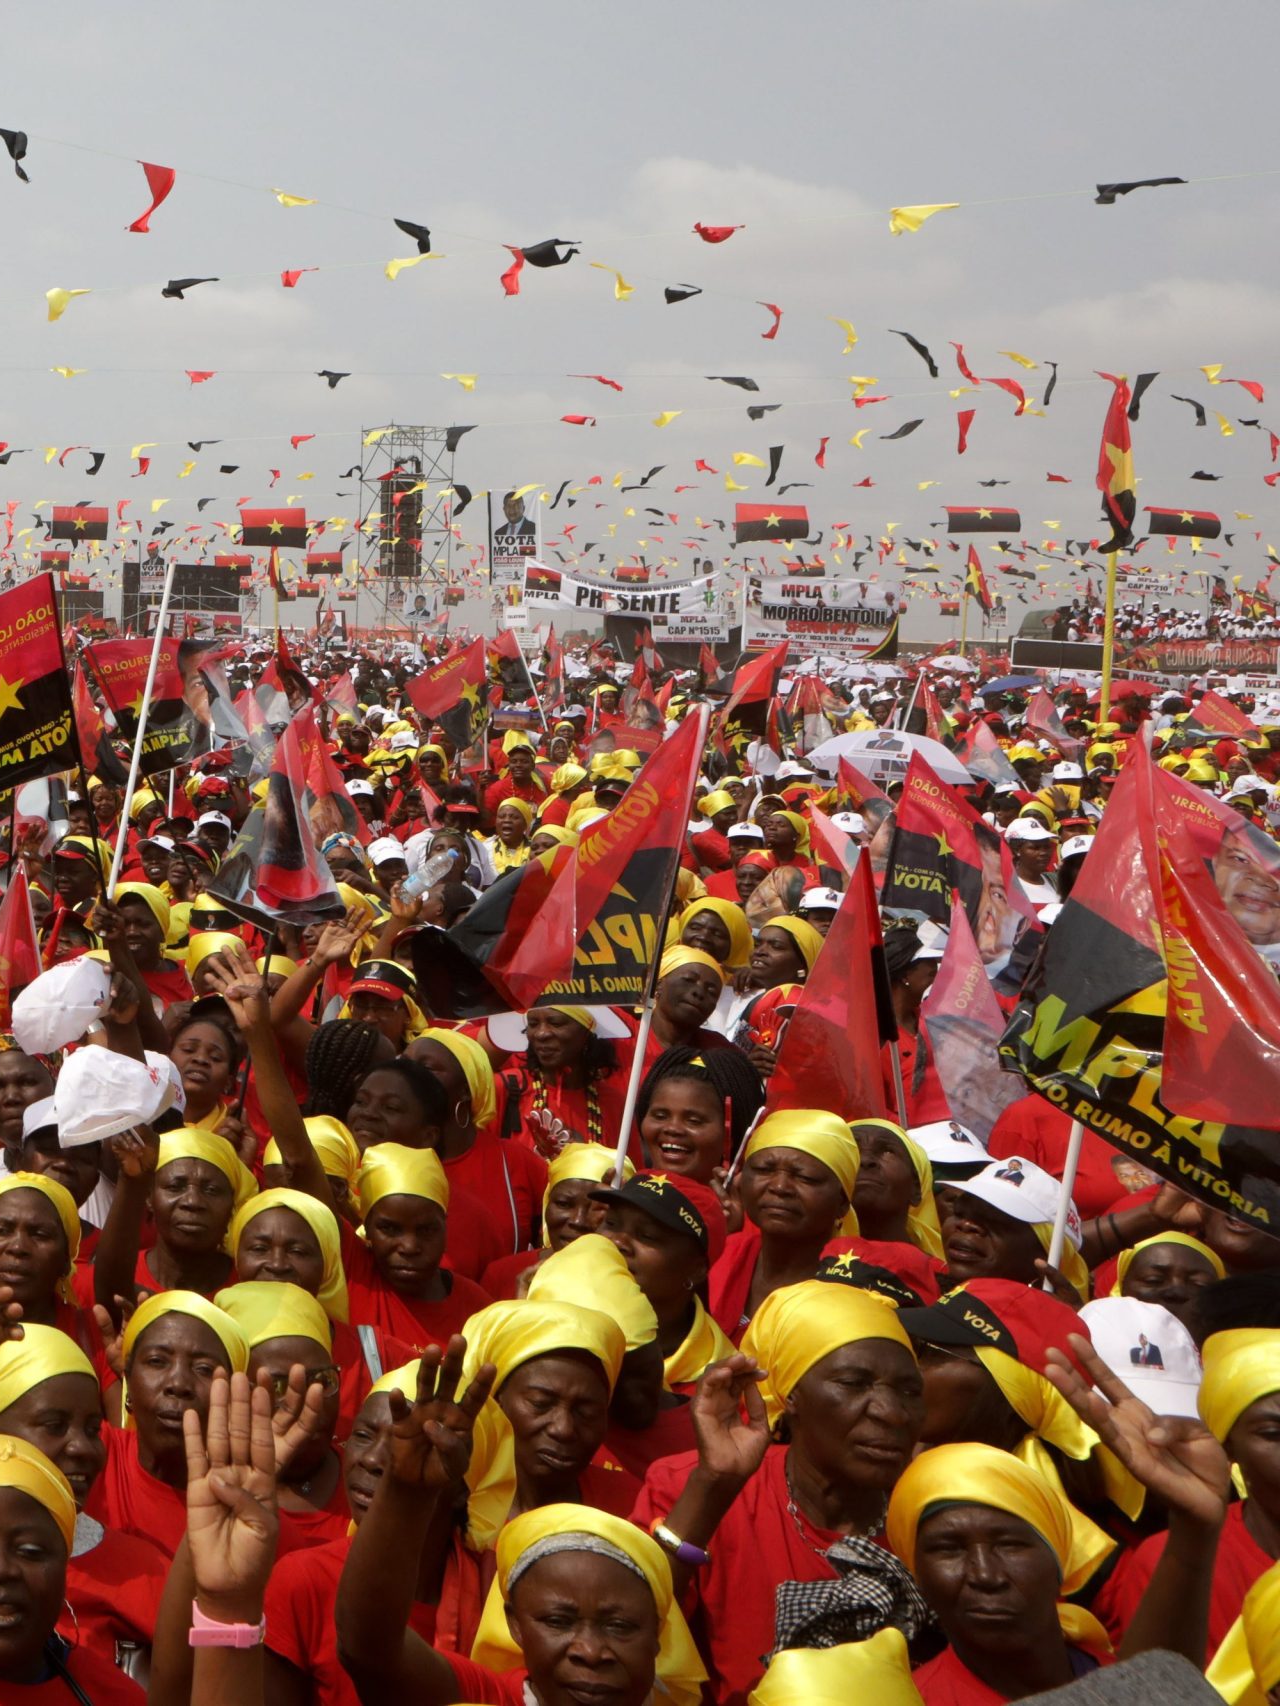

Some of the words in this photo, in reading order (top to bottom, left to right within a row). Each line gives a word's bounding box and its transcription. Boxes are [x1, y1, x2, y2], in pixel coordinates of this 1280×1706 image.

[494, 536, 536, 545] VOTA
[493, 546, 519, 556] MPLA
[524, 590, 560, 601] MPLA
[781, 584, 823, 599] MPLA
[680, 616, 707, 624] MPLA
[763, 605, 820, 621] MORRO
[822, 607, 871, 623] BENTO
[668, 626, 687, 635] CAP
[114, 653, 171, 672] LOUREÇO
[1165, 649, 1185, 666] COM
[1188, 649, 1193, 666] O
[153, 732, 191, 751] MPLA
[911, 775, 940, 797] JOÃO
[907, 790, 946, 816] RESIDENTE
[894, 870, 943, 894] VOTA
[1020, 994, 1226, 1169] MPLA
[1073, 1102, 1152, 1150] RUMO
[1153, 1145, 1173, 1165] À
[1178, 1157, 1271, 1225] VITÓRIA
[638, 1181, 664, 1196] MPLA
[679, 1207, 703, 1237] VOTA
[826, 1267, 853, 1279] MPLA
[963, 1310, 1001, 1341] VOTA
